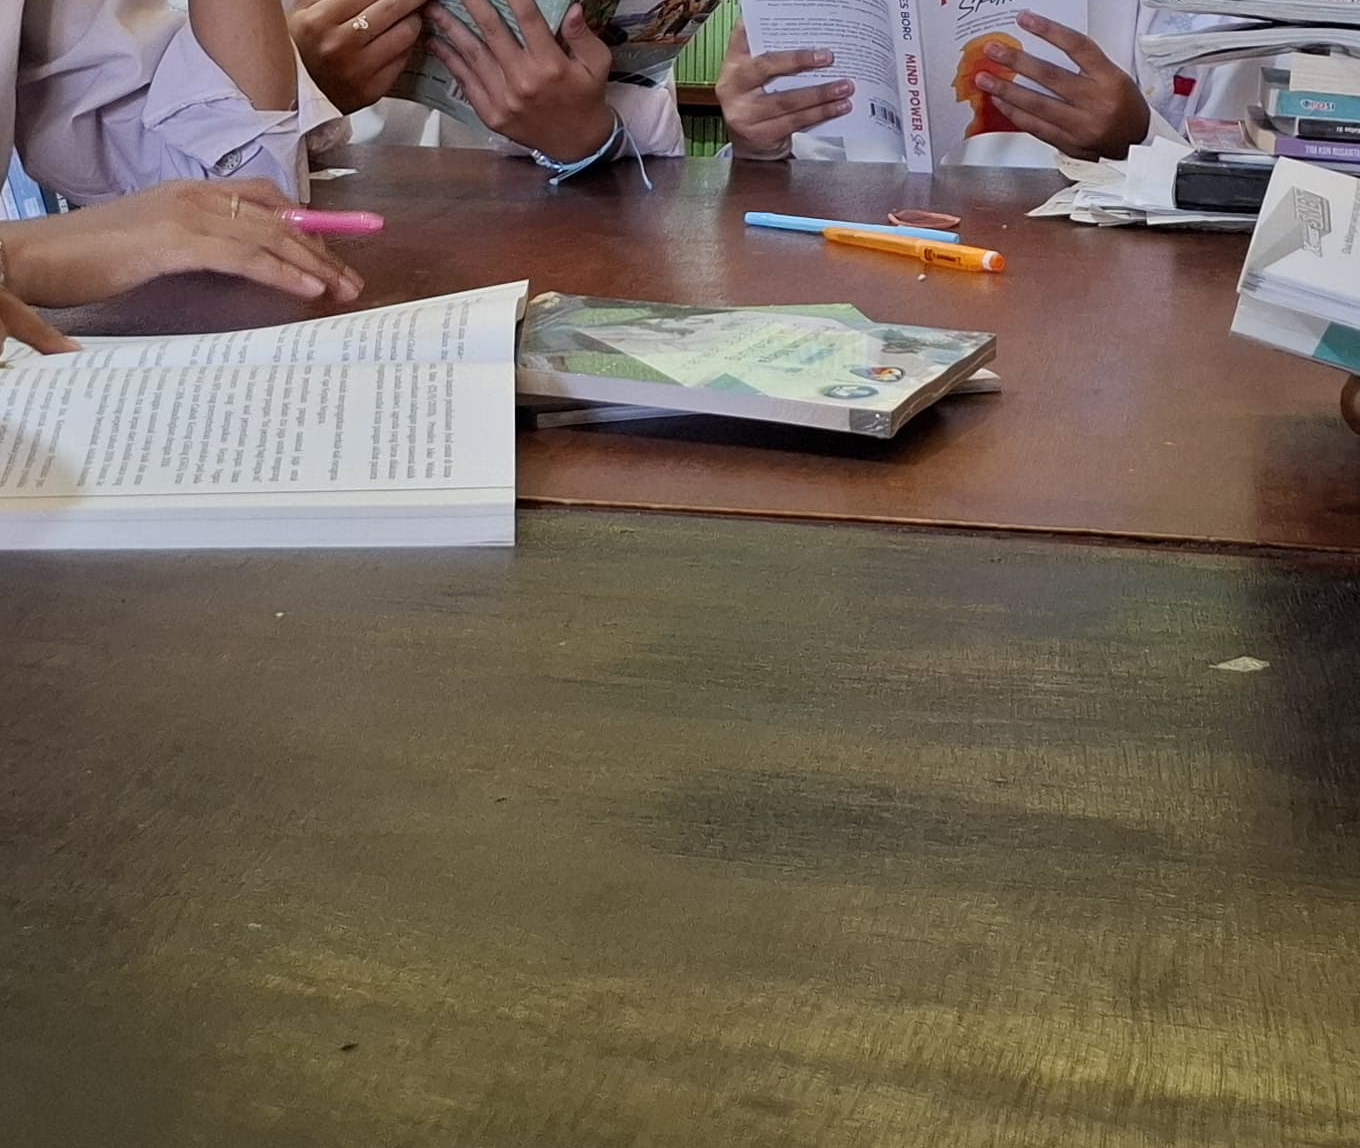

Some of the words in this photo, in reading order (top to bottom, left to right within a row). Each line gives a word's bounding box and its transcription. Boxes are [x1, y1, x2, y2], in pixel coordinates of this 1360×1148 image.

[900, 10, 912, 42] BORG
[904, 53, 918, 86] MIND
[908, 89, 923, 132] POWER
